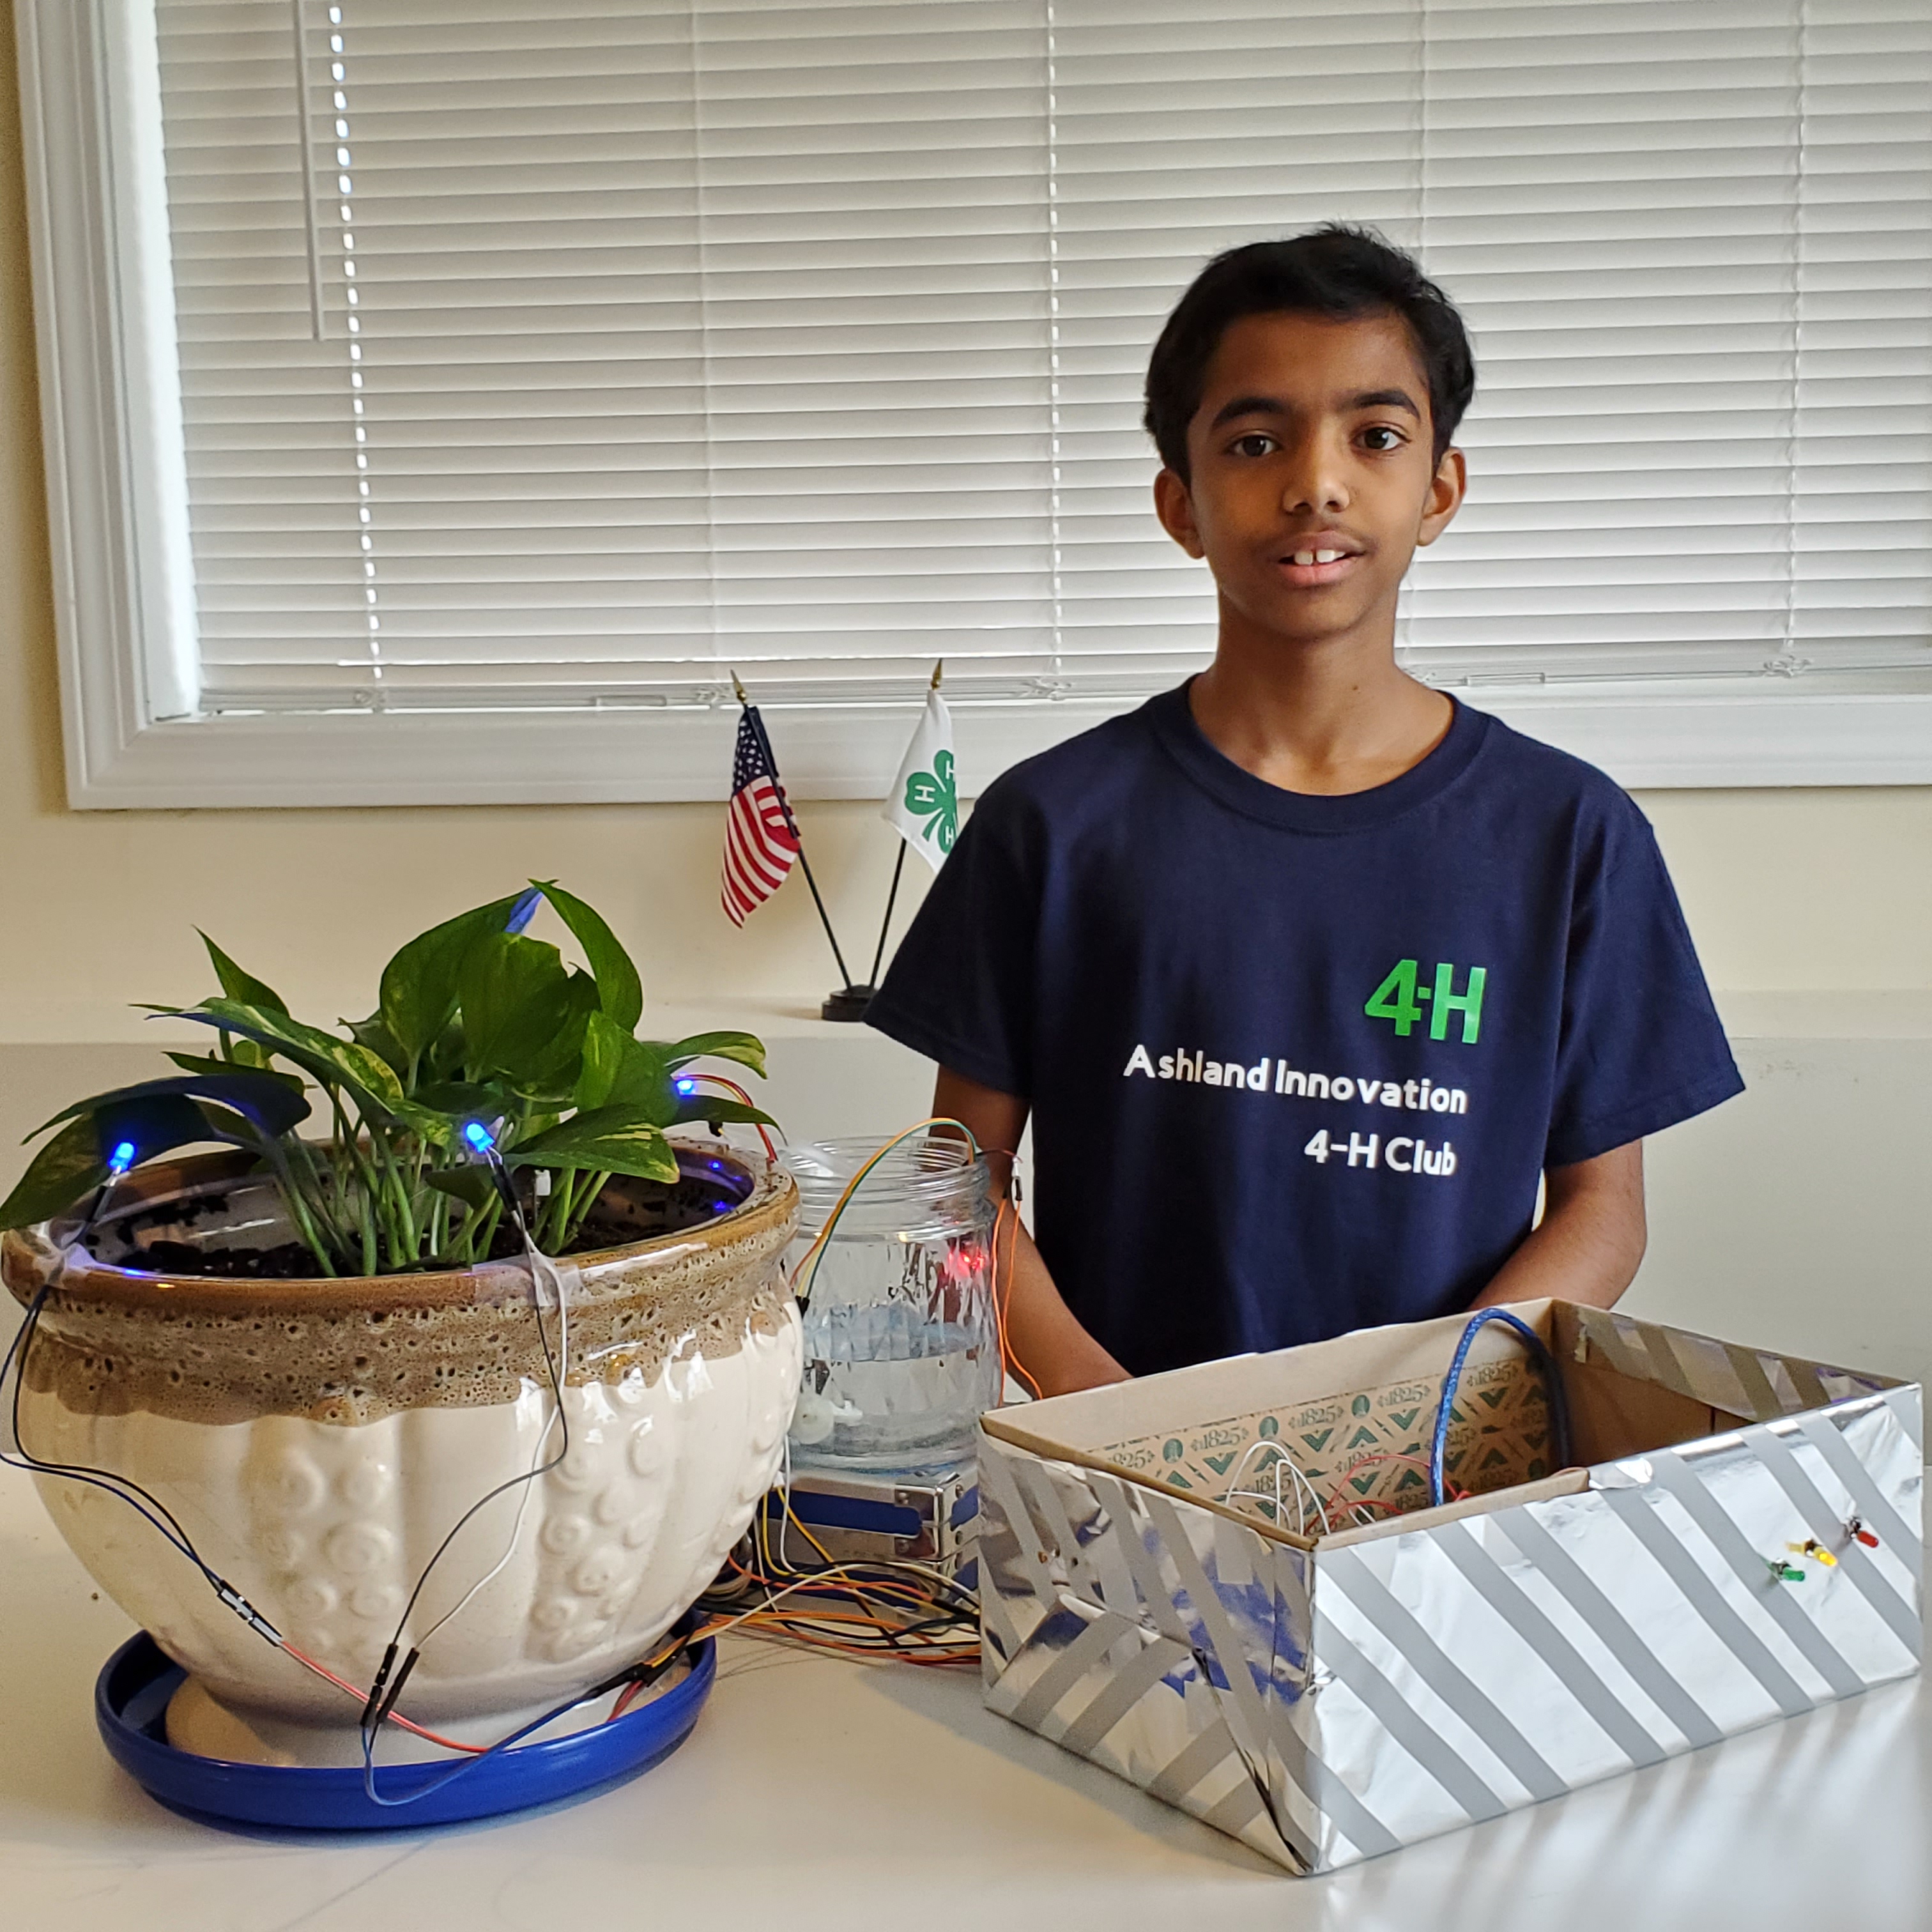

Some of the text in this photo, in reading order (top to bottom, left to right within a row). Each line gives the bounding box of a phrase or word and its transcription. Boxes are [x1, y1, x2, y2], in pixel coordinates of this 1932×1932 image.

[914, 785, 935, 802] H
[1365, 959, 1487, 1044] 4-H
[1123, 1044, 1468, 1115] Ashland Innovation
[1304, 1129, 1457, 1176] 4-H Club
[1388, 1384, 1424, 1406] 1825
[1301, 1405, 1337, 1427] 1825
[1202, 1425, 1241, 1450] 1825
[1107, 1448, 1147, 1469] 825
